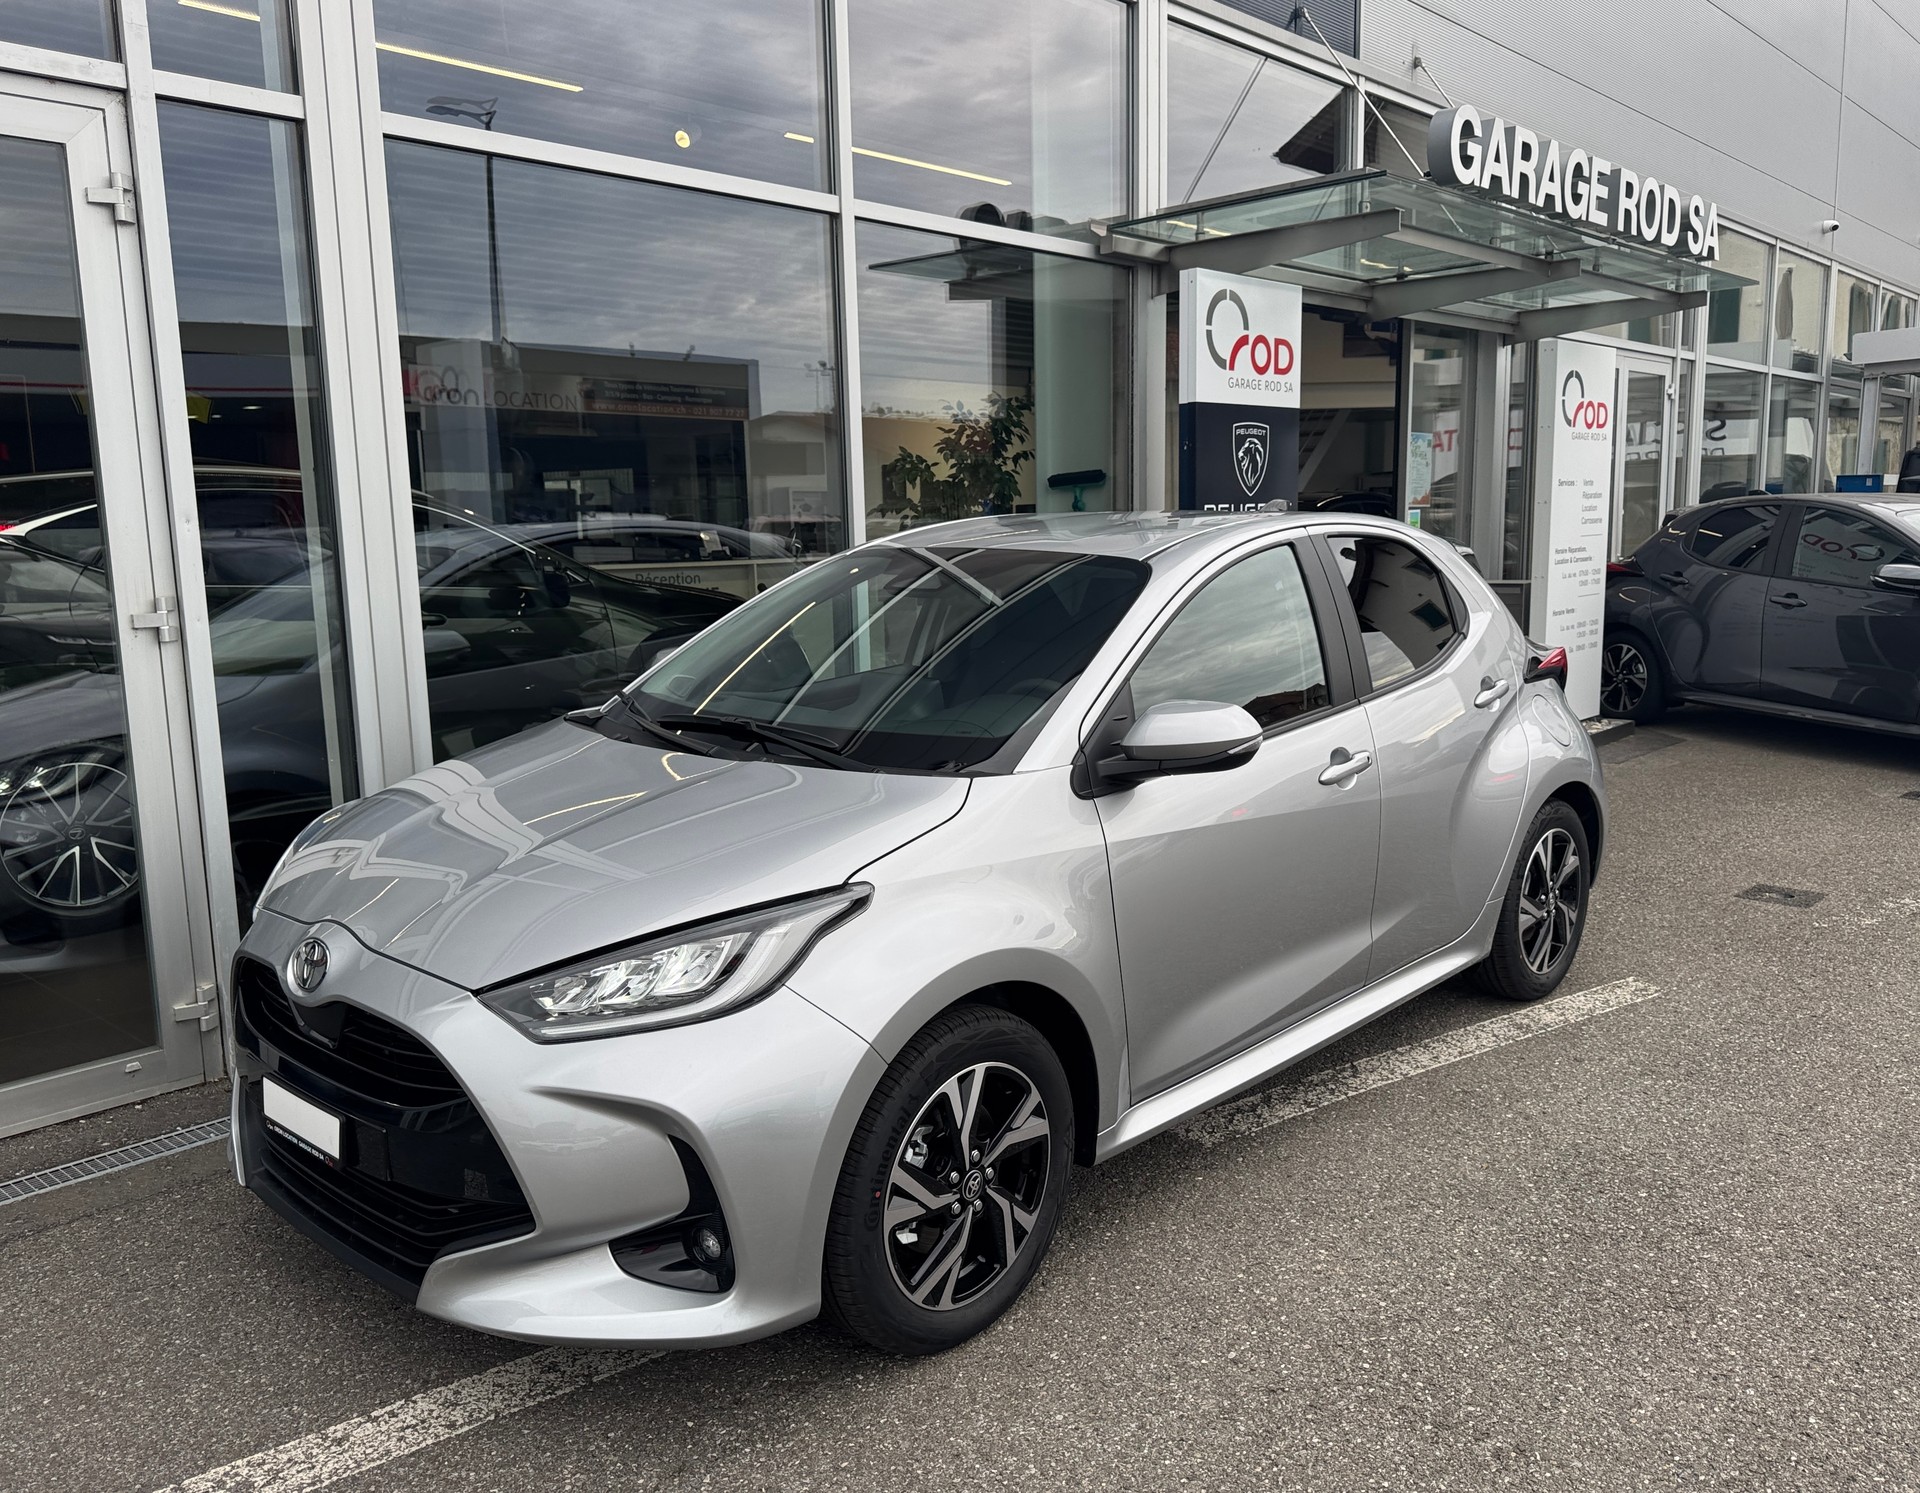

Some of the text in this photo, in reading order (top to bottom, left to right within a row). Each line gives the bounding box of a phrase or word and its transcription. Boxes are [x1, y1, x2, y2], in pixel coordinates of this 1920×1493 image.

[1451, 104, 1720, 261] GARAGE ROD SA
[1228, 377, 1294, 393] GARAGE ROD SA
[1236, 428, 1267, 436] PEUGEOT
